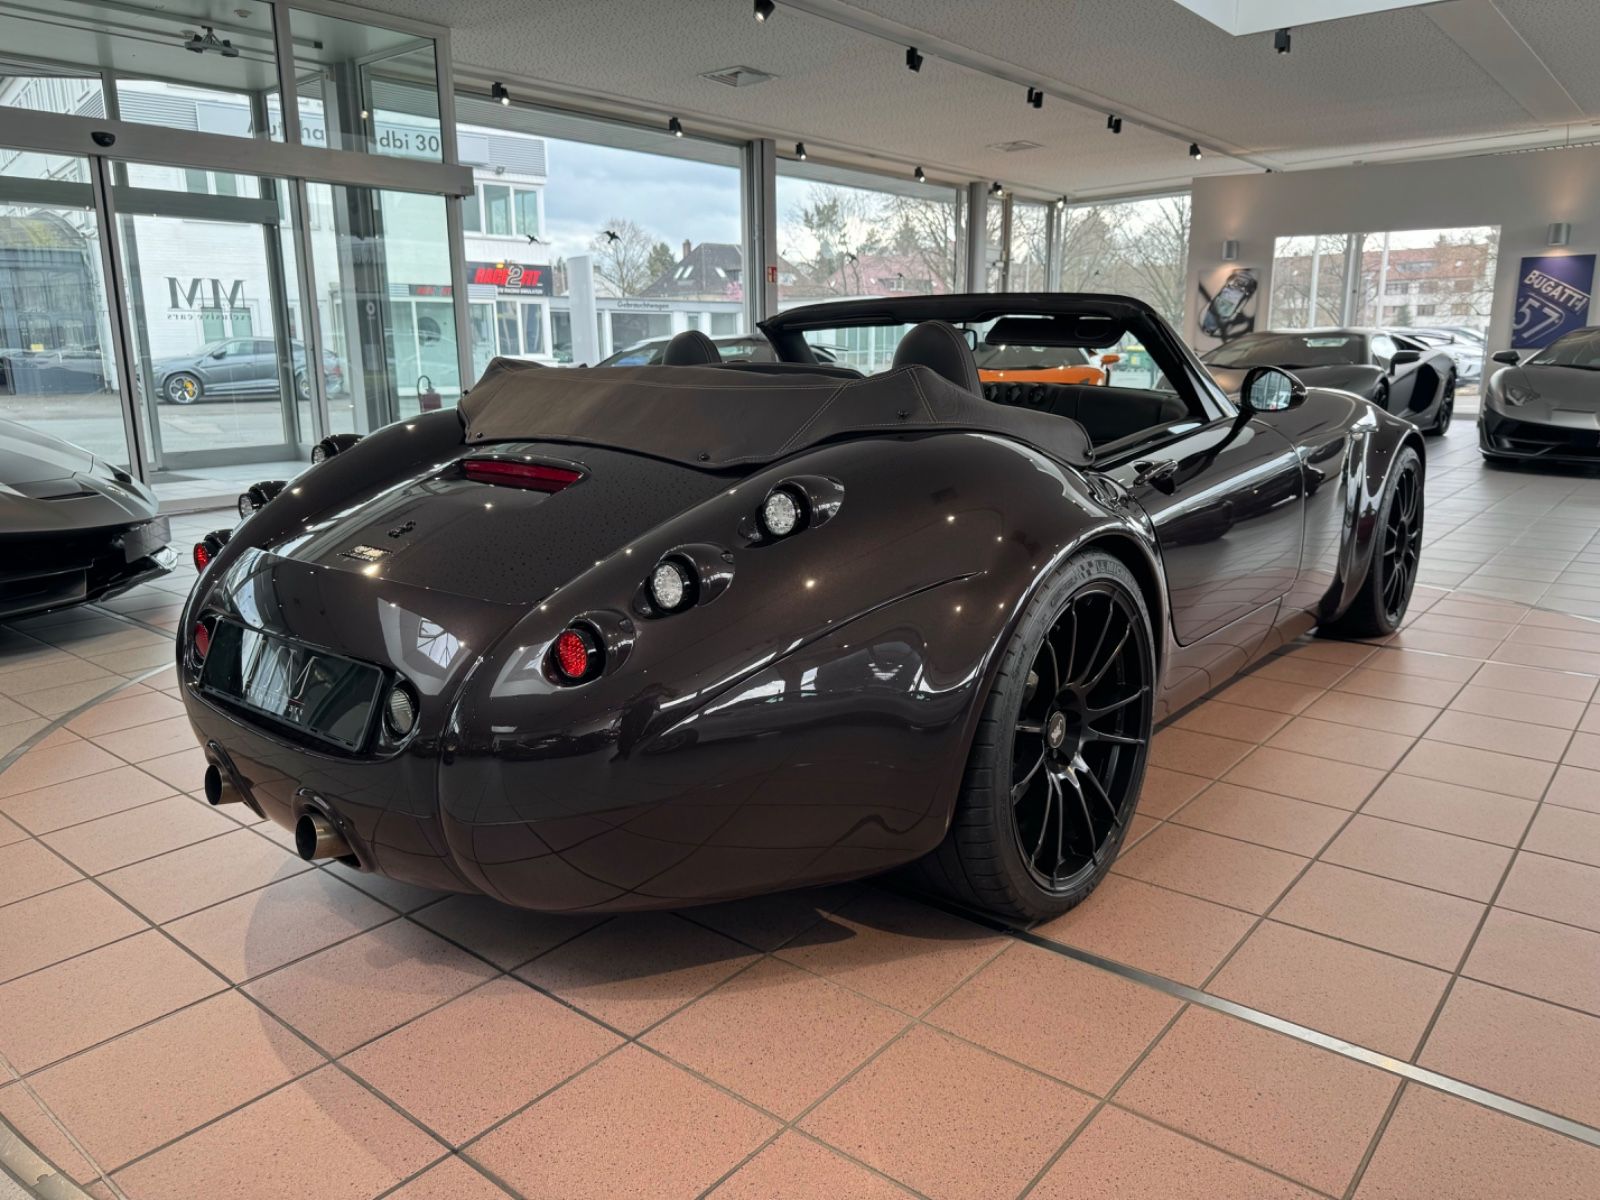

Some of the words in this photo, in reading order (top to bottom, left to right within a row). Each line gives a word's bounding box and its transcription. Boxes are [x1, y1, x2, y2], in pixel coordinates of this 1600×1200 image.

[415, 133, 440, 153] 30
[1523, 269, 1588, 312] BUGATTI
[1512, 297, 1561, 339] 57
